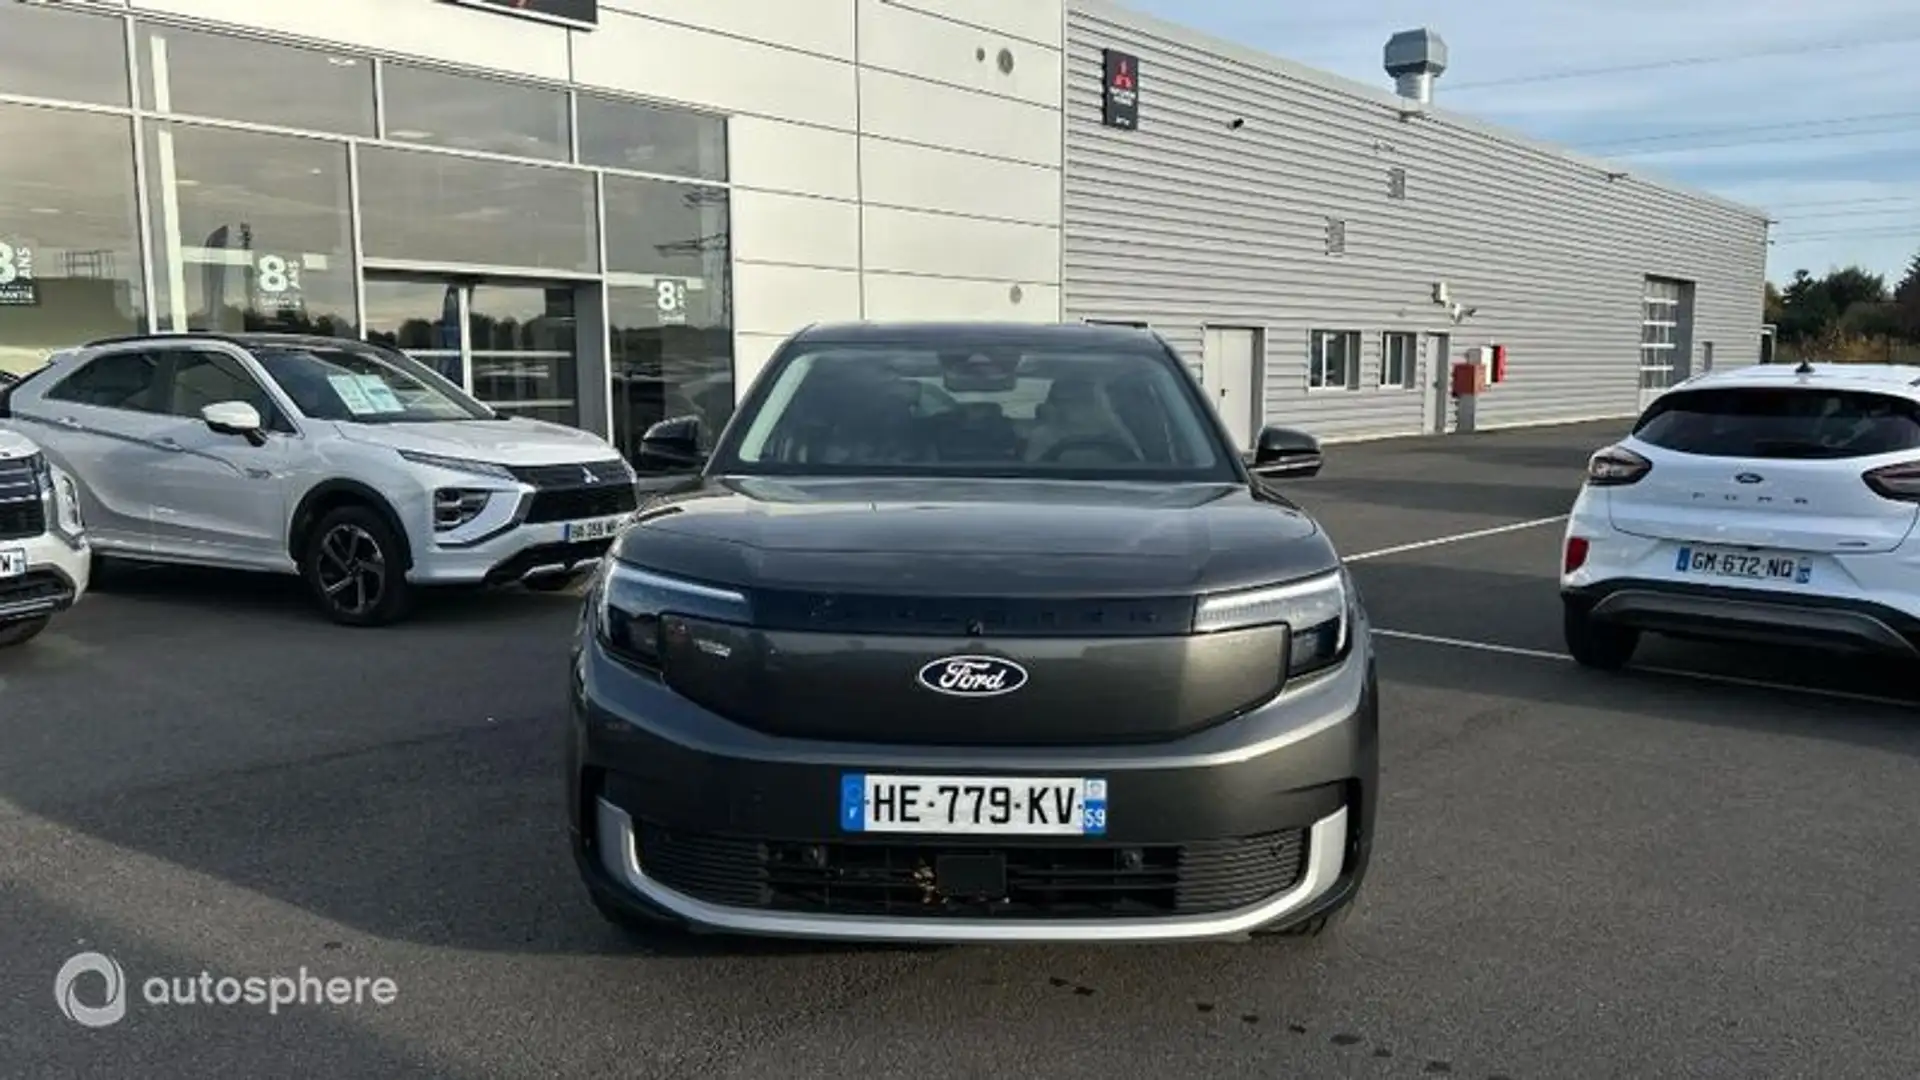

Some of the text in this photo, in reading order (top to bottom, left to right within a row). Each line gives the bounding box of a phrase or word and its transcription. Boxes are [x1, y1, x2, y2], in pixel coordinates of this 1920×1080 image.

[16, 247, 33, 279] ANS
[260, 255, 288, 292] 8
[658, 281, 676, 310] 8
[939, 661, 1007, 689] Ford
[1084, 808, 1106, 828] 59
